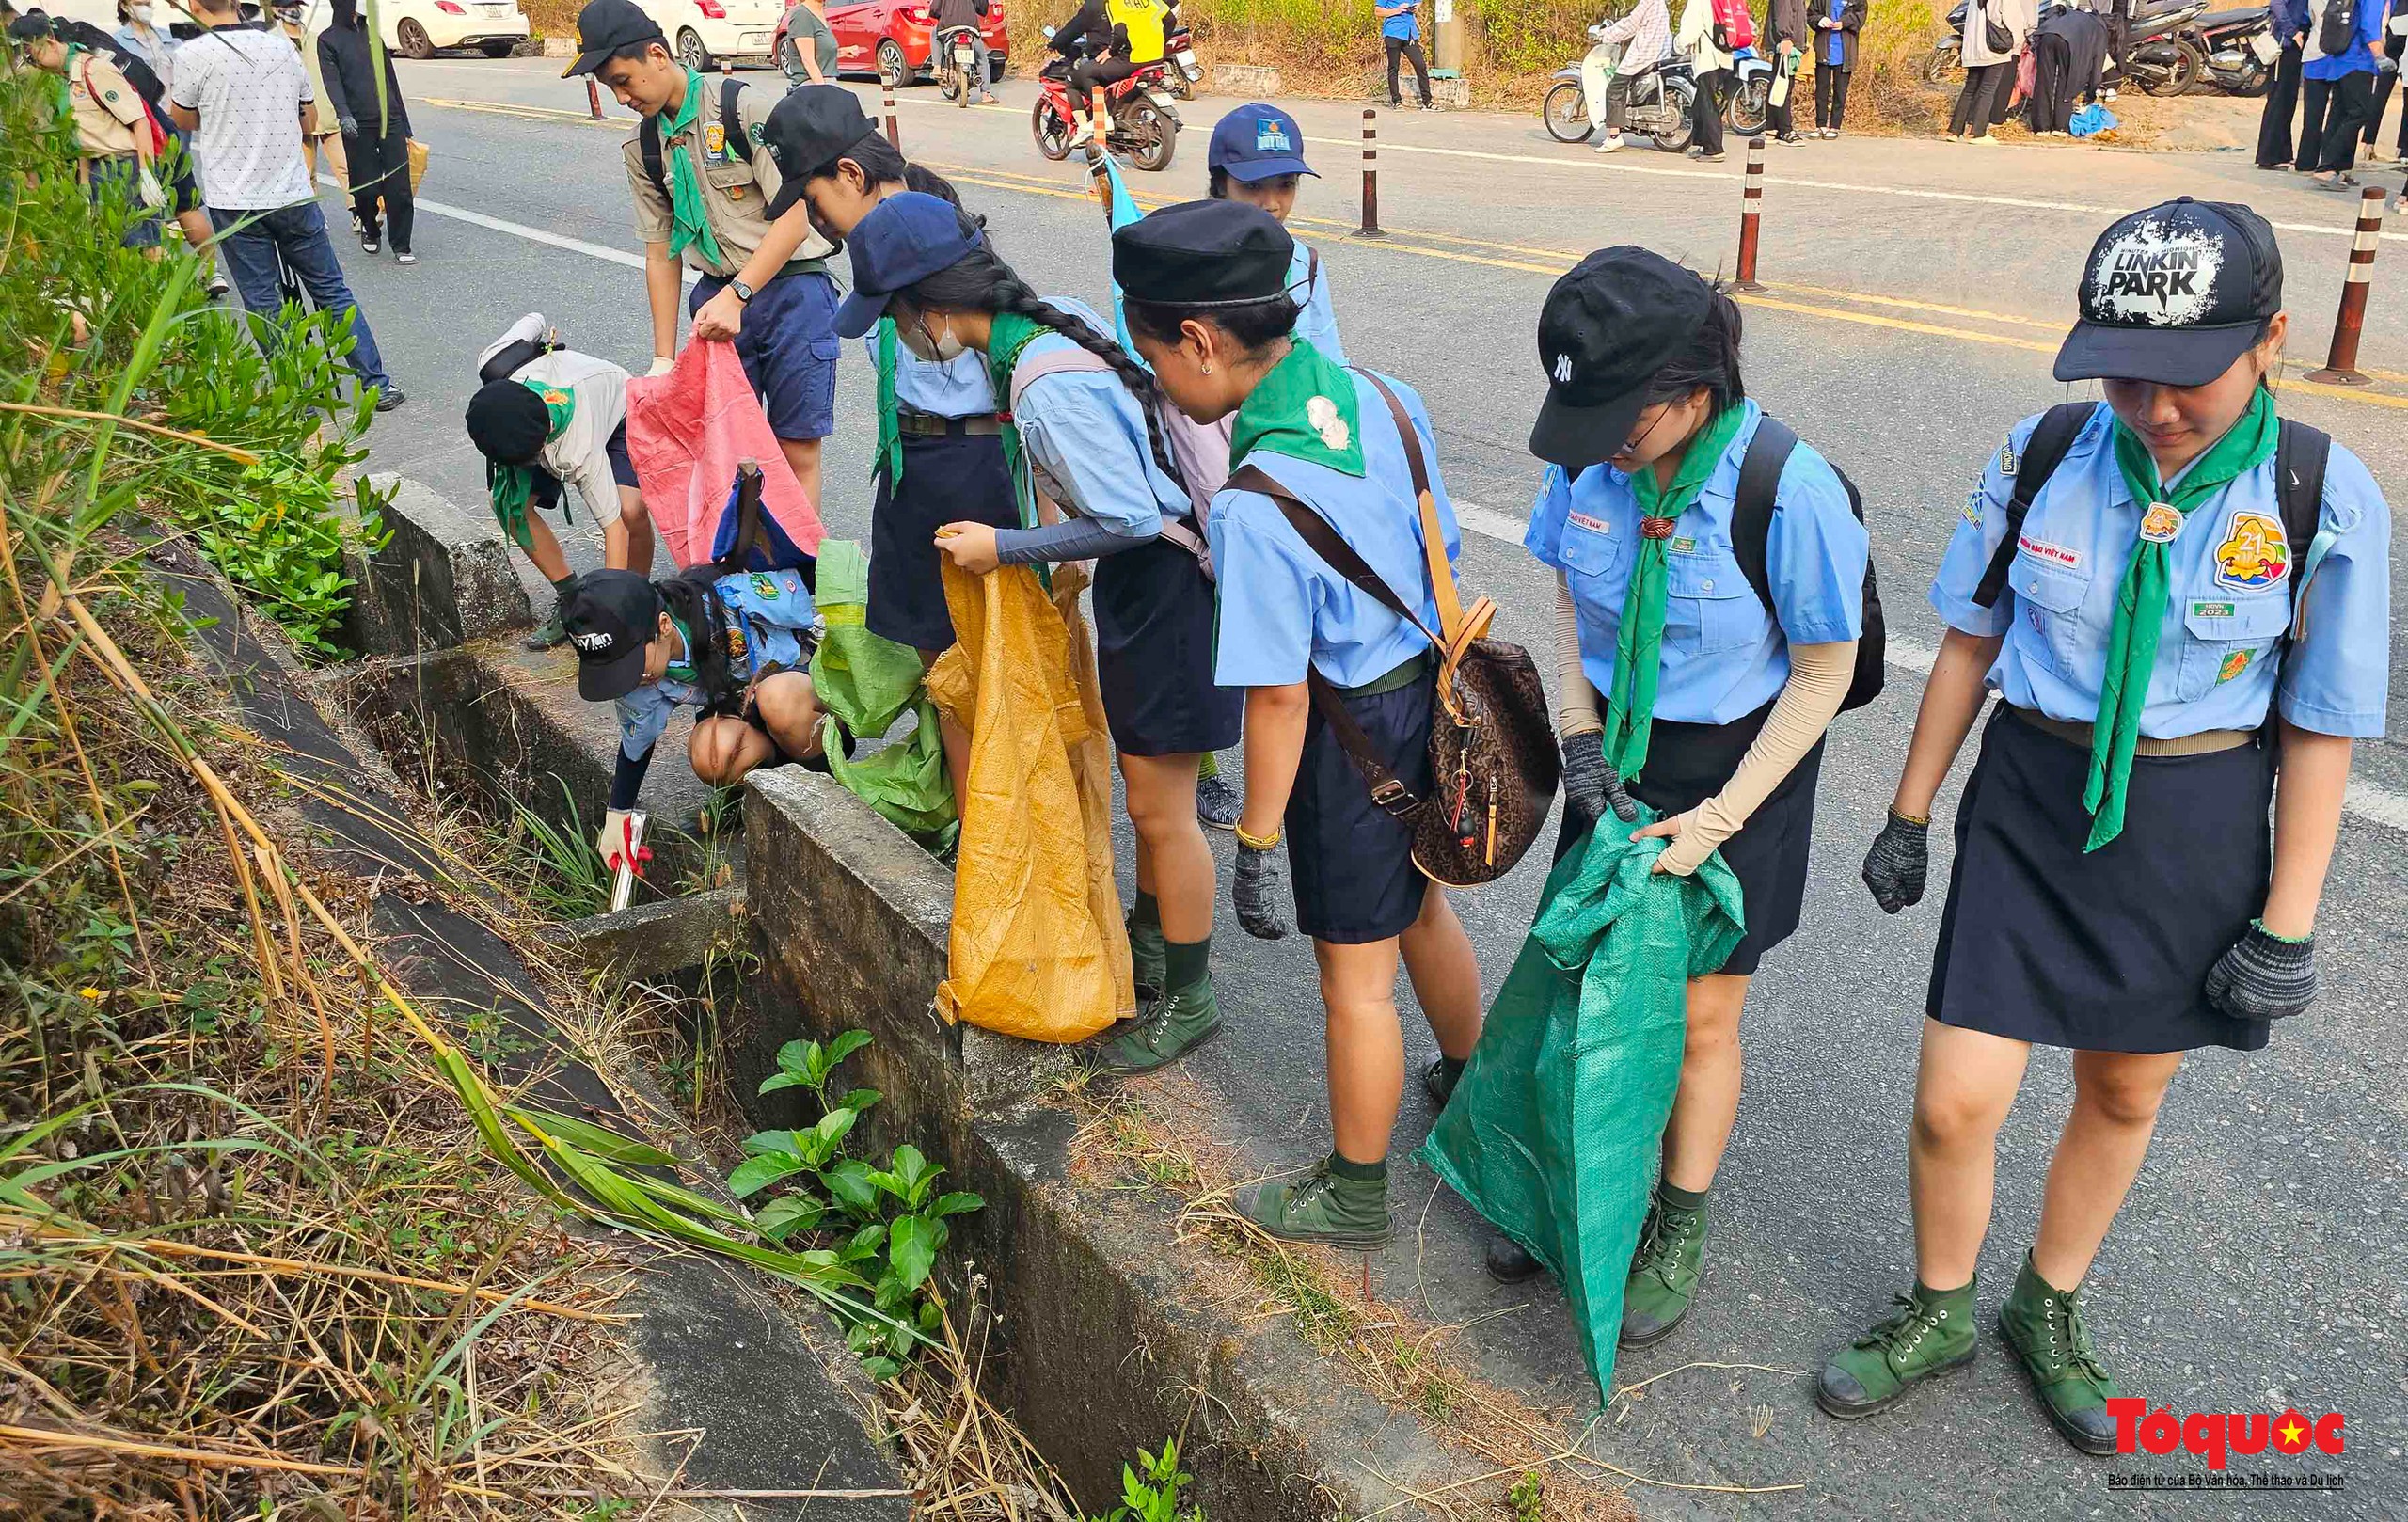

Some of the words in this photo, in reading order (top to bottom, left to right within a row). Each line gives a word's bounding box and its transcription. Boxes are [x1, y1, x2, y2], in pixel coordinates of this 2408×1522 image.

[2113, 252, 2198, 275] LINKIN
[2107, 270, 2197, 309] PARK
[2238, 531, 2263, 554] 21
[2059, 552, 2075, 563] NAM
